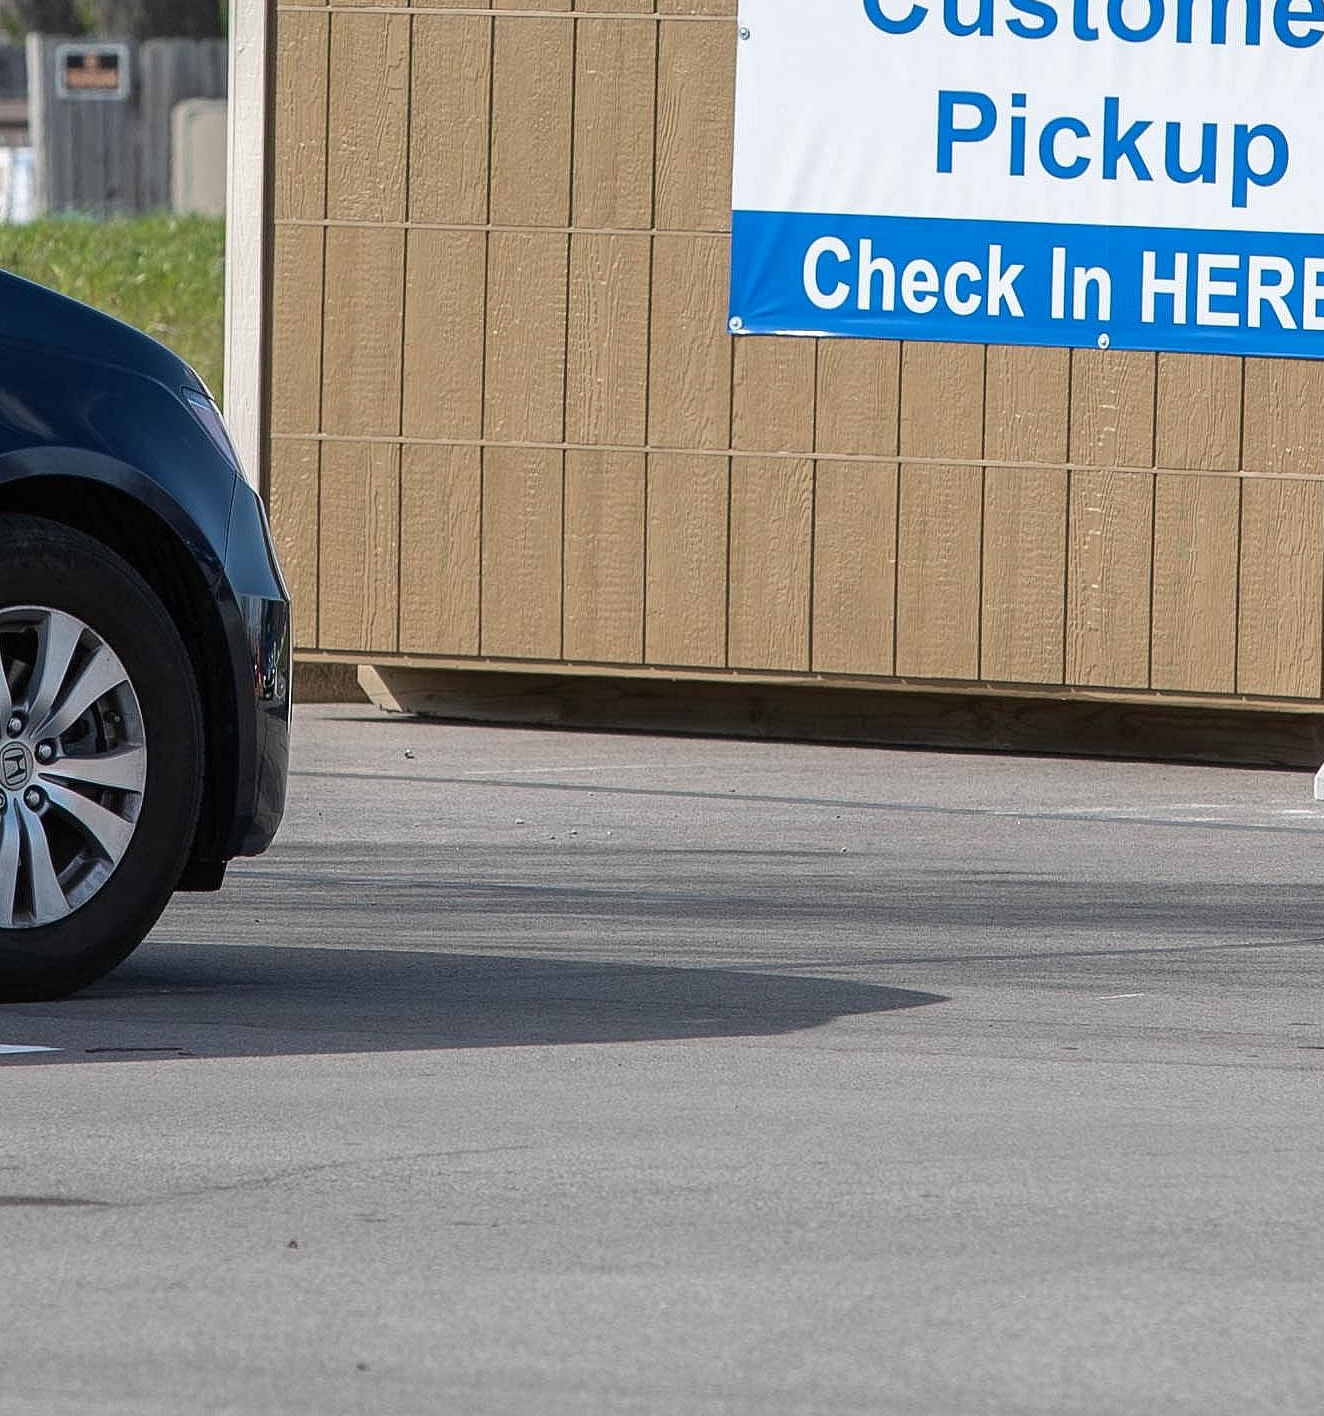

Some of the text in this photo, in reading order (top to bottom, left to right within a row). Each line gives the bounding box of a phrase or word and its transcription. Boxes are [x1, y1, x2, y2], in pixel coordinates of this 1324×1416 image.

[936, 90, 1289, 209] Pickup
[803, 236, 1025, 318] Check
[1051, 247, 1112, 322] In
